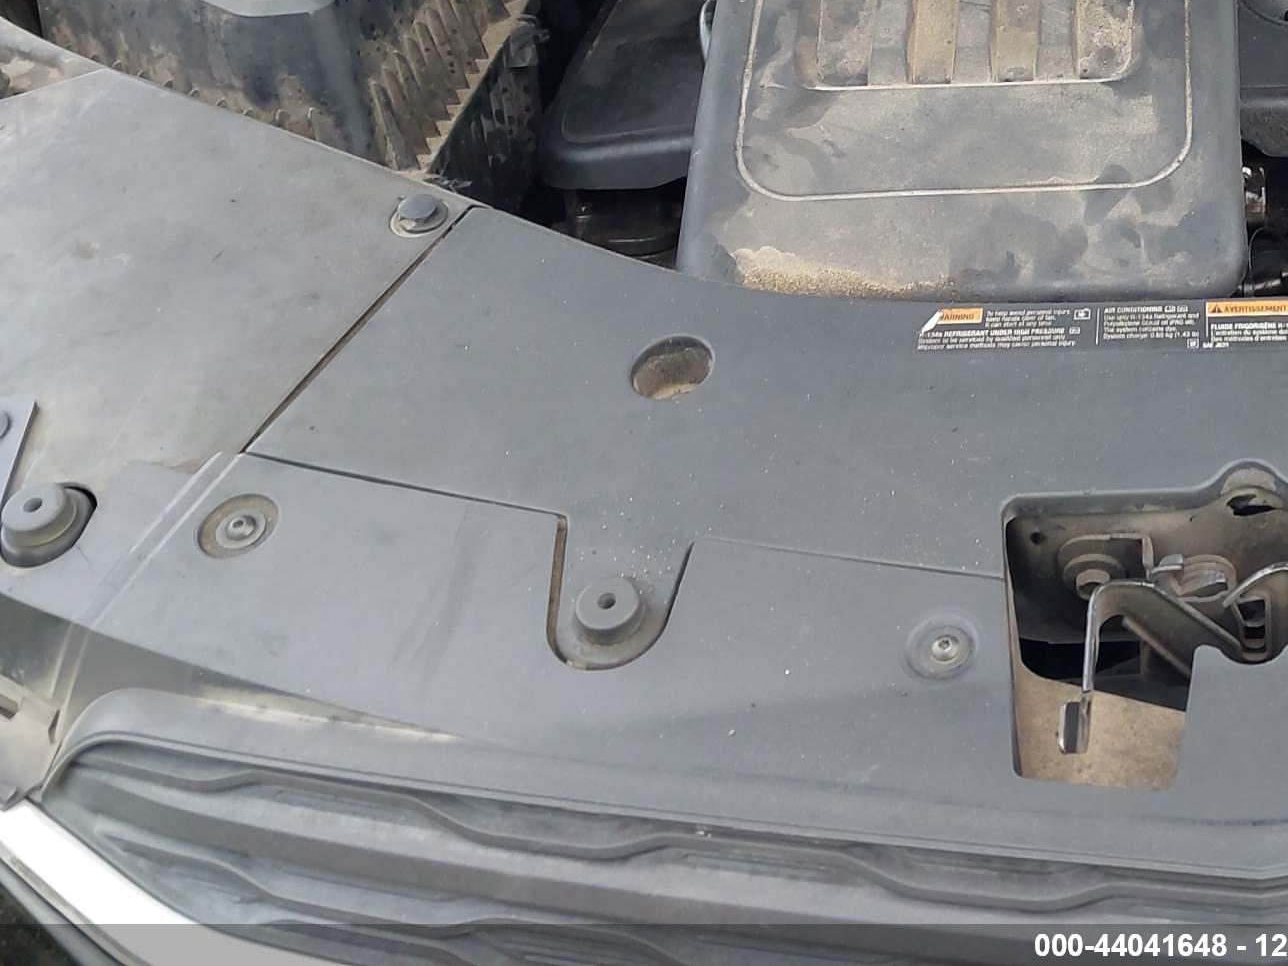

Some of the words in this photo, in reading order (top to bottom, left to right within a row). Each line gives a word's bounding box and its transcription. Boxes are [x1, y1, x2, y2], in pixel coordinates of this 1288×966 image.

[1117, 305, 1163, 313] CONDITIONING
[1224, 305, 1287, 313] AVERTISSEMENT
[944, 330, 989, 338] REFRIGERANT
[989, 328, 1013, 336] UNDER
[1013, 328, 1030, 336] HIGH
[1030, 327, 1065, 335] PRESSURE
